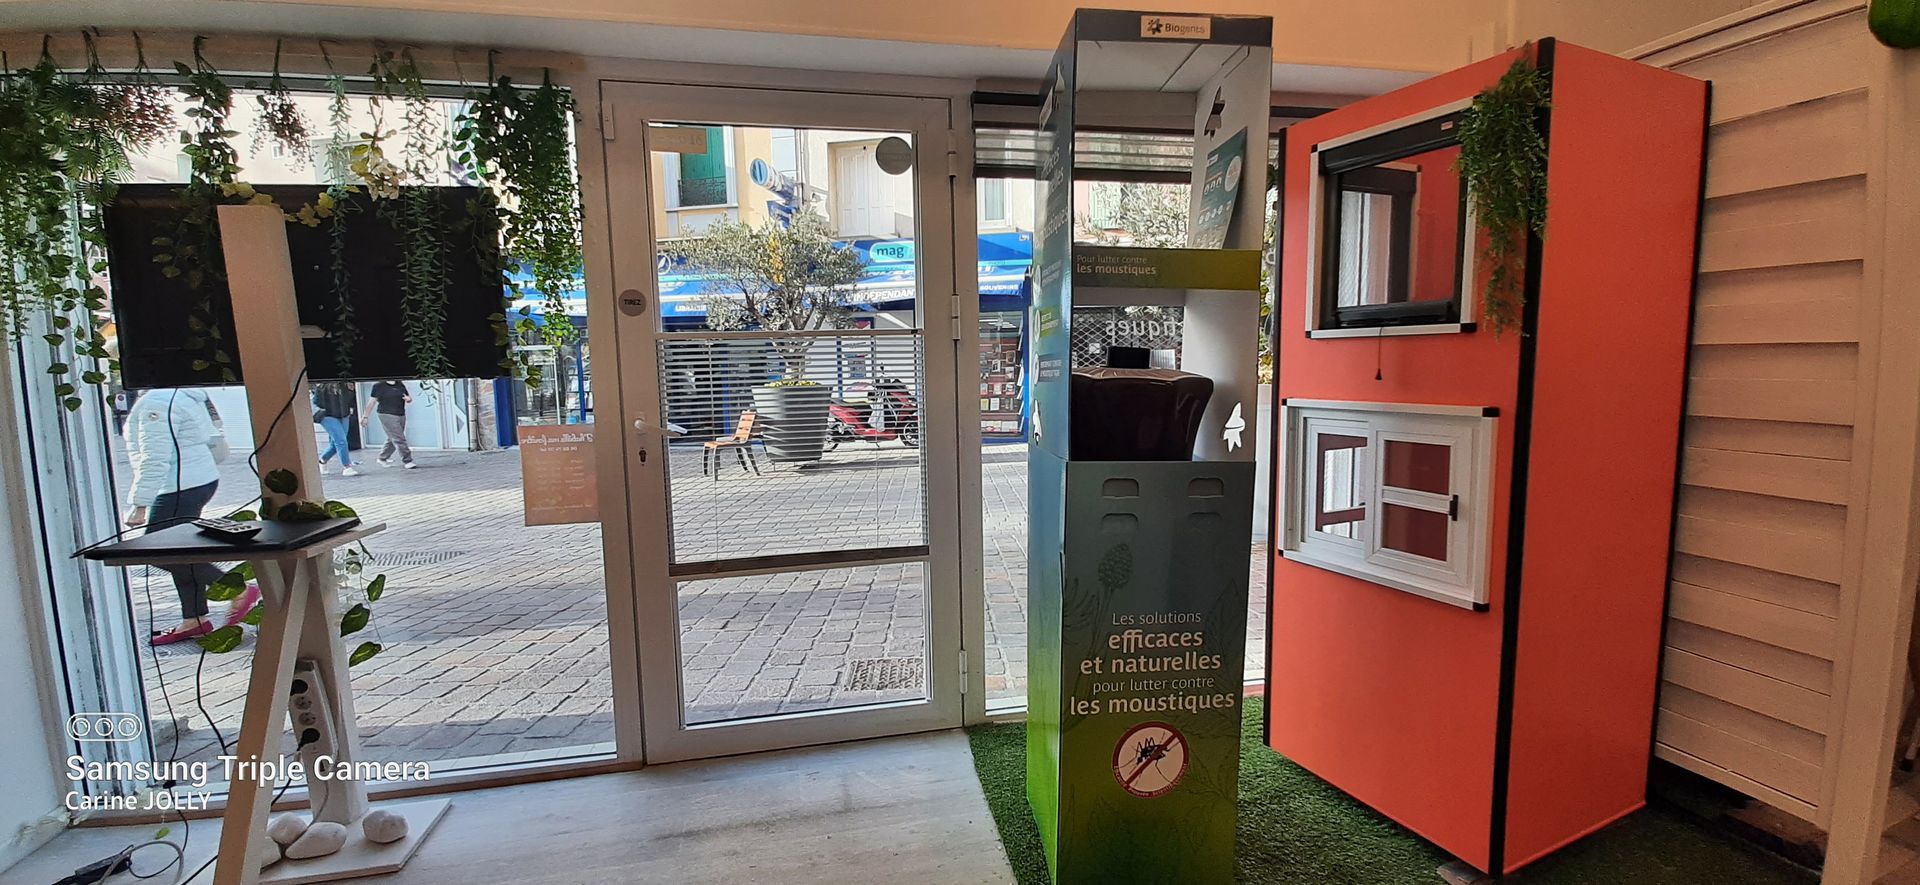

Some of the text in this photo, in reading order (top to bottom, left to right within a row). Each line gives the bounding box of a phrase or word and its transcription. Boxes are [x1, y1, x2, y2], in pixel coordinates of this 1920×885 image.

[1165, 22, 1205, 35] Biogents
[876, 244, 904, 261] mag
[1076, 254, 1147, 264] Pour lutter contre
[1076, 264, 1156, 277] les moustiques
[624, 298, 641, 306] TIREZ
[1112, 611, 1201, 626] Les solutions
[1108, 629, 1203, 654] efficaces
[1080, 652, 1222, 674] et naturelles
[1092, 675, 1215, 695] pour lutter contre
[1070, 691, 1235, 716] les moustiques
